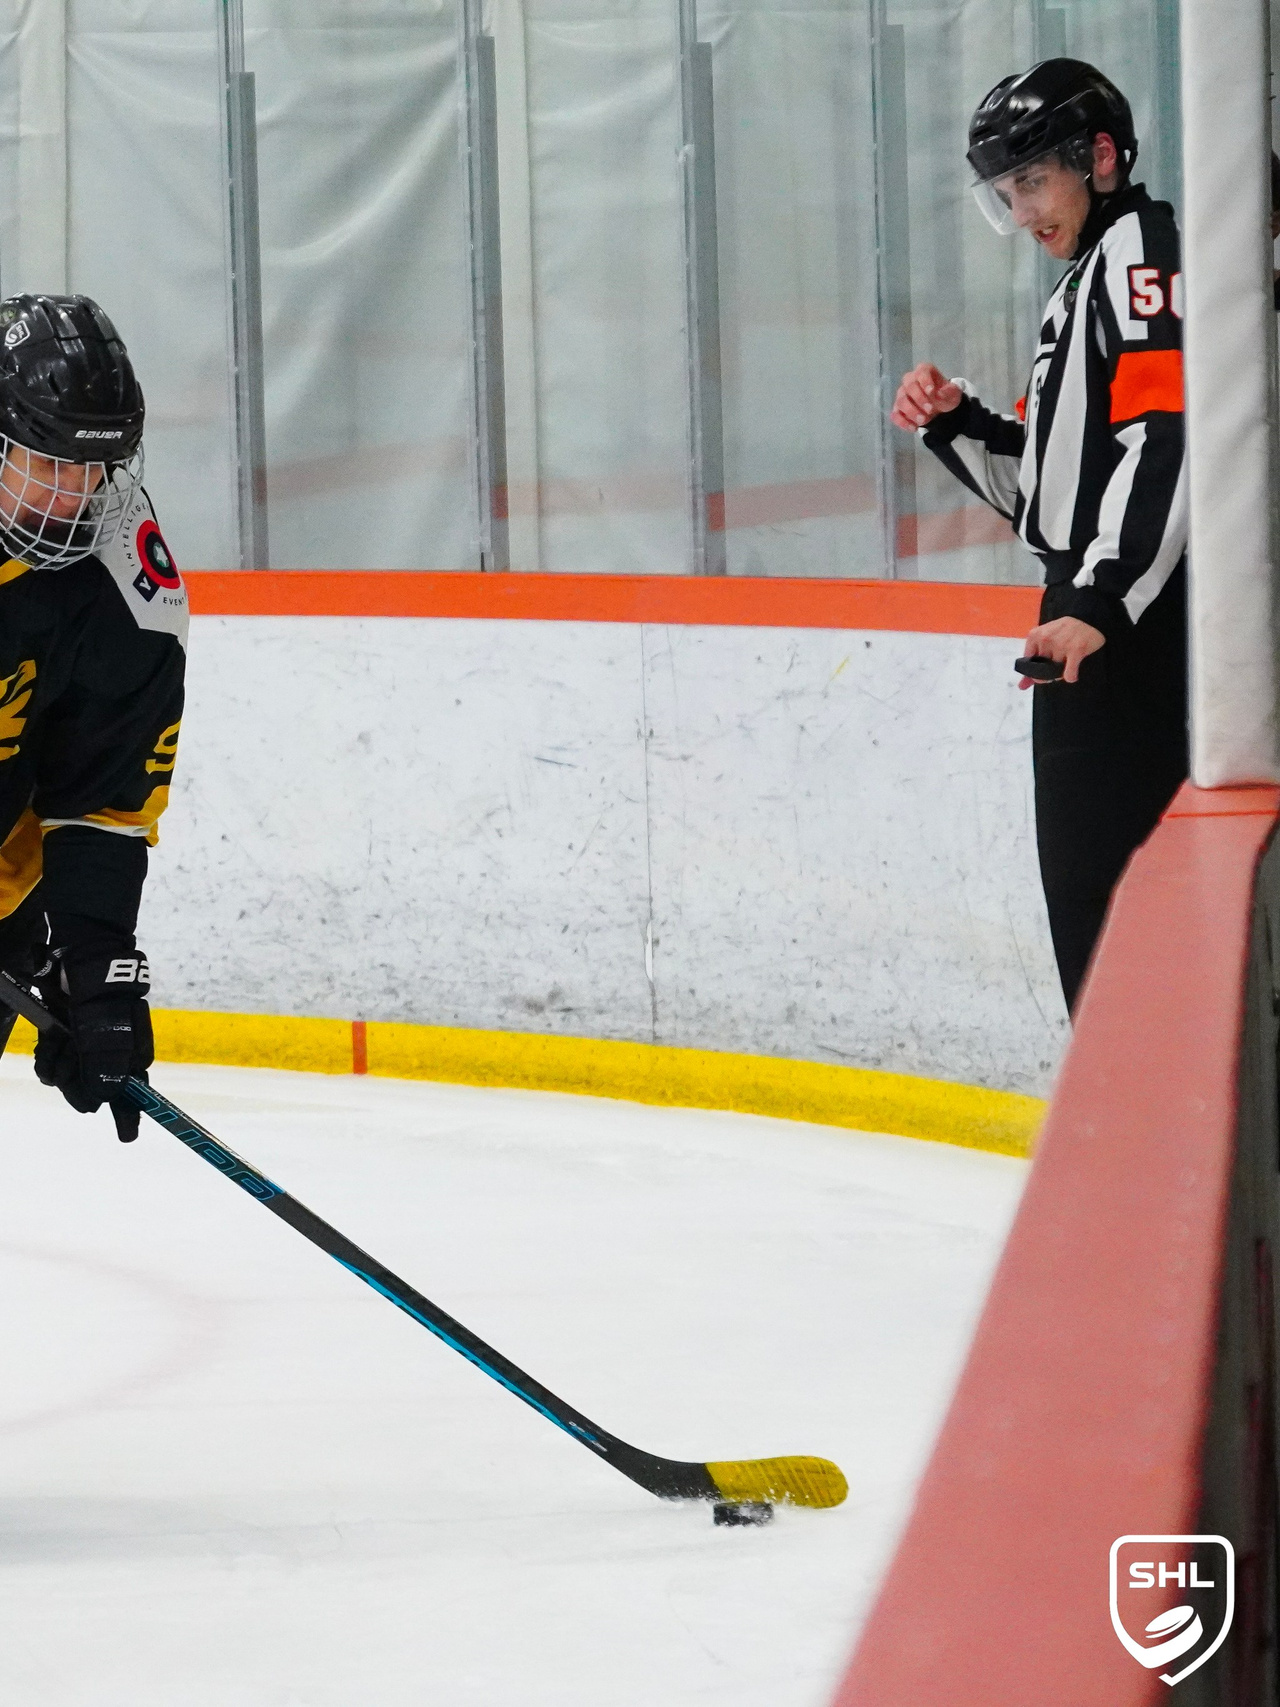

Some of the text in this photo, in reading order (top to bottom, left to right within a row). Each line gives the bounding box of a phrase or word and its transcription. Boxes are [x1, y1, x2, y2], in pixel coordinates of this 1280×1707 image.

[75, 430, 123, 439] BAUER
[162, 596, 185, 606] EVEN
[145, 720, 181, 775] 9
